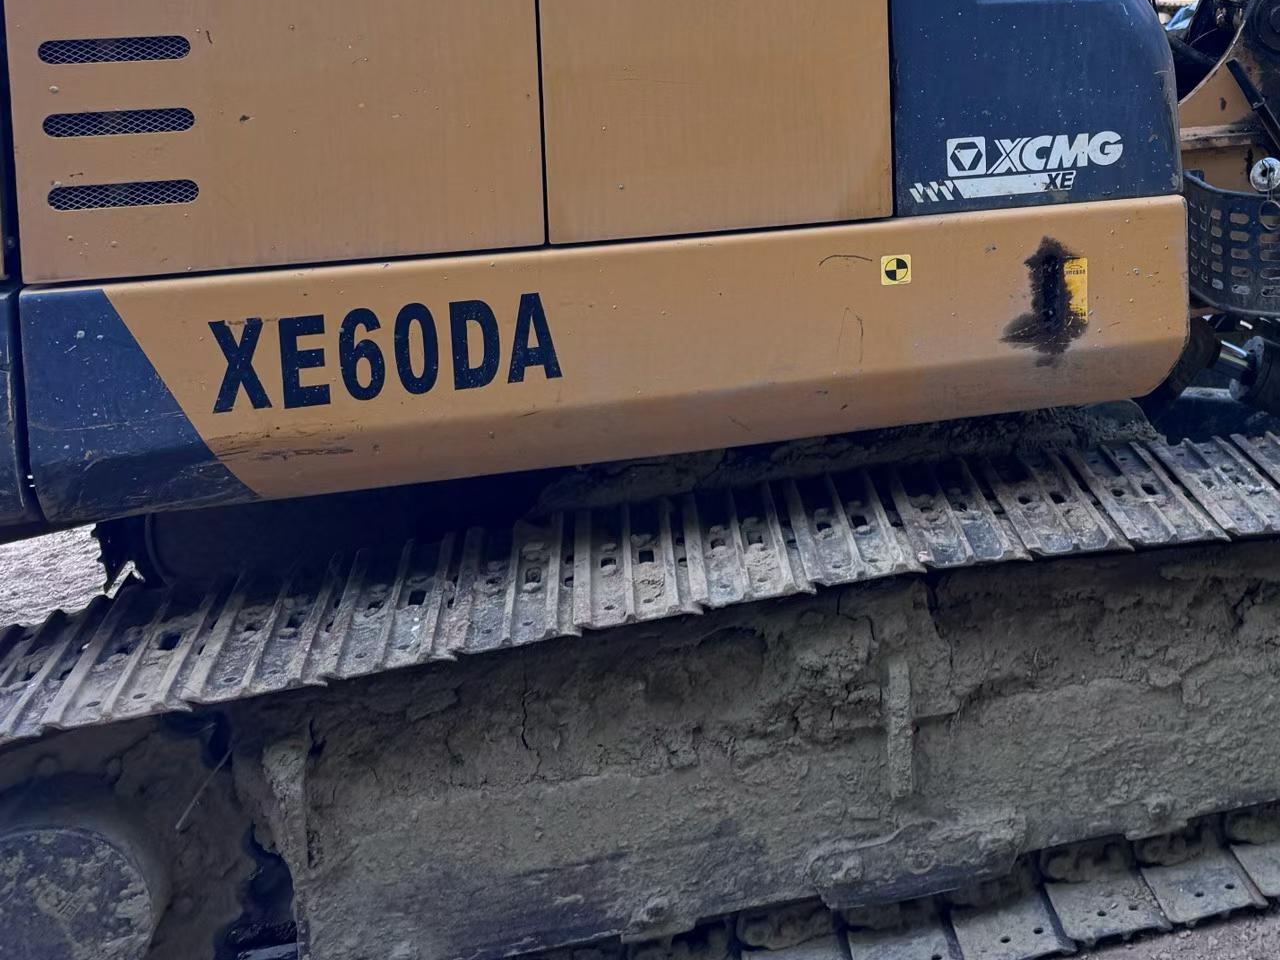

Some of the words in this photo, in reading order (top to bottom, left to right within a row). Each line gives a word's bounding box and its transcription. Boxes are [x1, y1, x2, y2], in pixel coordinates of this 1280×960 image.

[987, 131, 1123, 175] XCMG
[1044, 172, 1075, 190] XE
[207, 292, 563, 414] XE60DA
